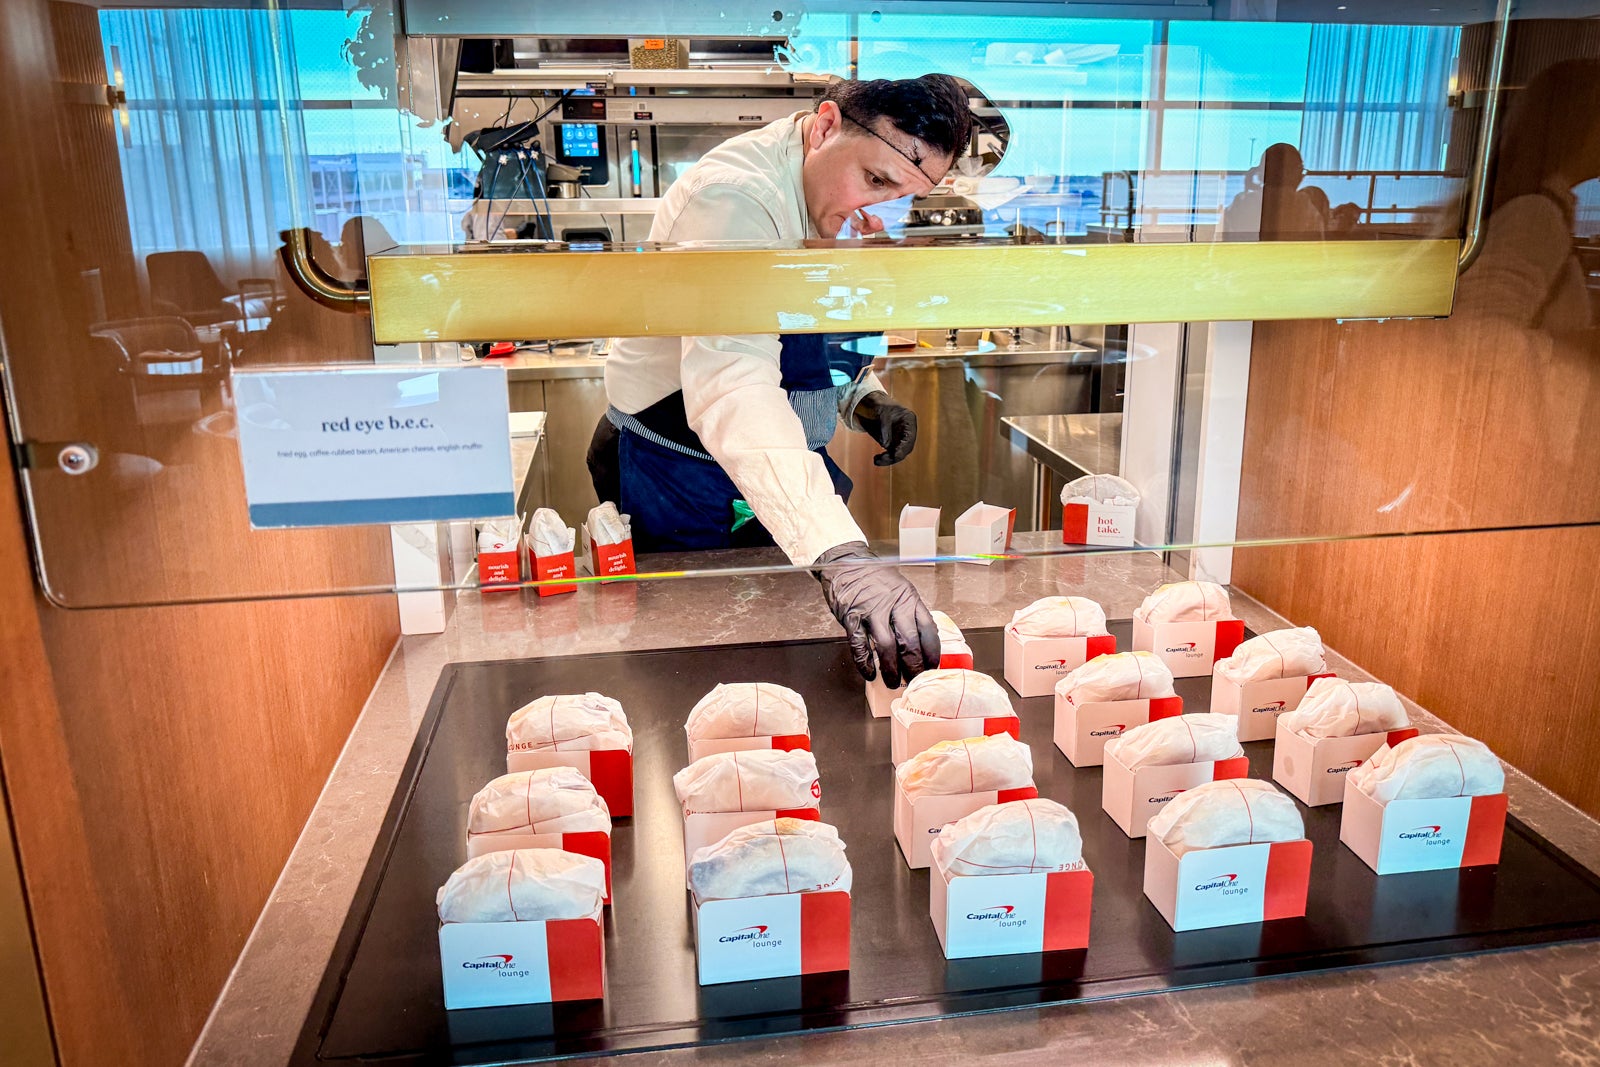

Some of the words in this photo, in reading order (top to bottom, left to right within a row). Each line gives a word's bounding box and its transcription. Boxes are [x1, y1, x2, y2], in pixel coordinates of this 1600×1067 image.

[322, 416, 350, 432] red
[355, 419, 384, 434] eye
[389, 416, 434, 430] b.e.c.
[294, 451, 308, 459] egg,
[309, 449, 356, 458] coffee-rubbed
[356, 448, 378, 456] bacon,
[379, 446, 410, 455] American
[1098, 516, 1113, 525] hot
[1097, 526, 1120, 534] take.
[608, 552, 627, 561] nourish
[546, 564, 568, 574] nourish
[1222, 886, 1248, 896] lounge
[999, 919, 1026, 928] lounge
[752, 939, 782, 948] lounge
[498, 970, 530, 978] lounge
